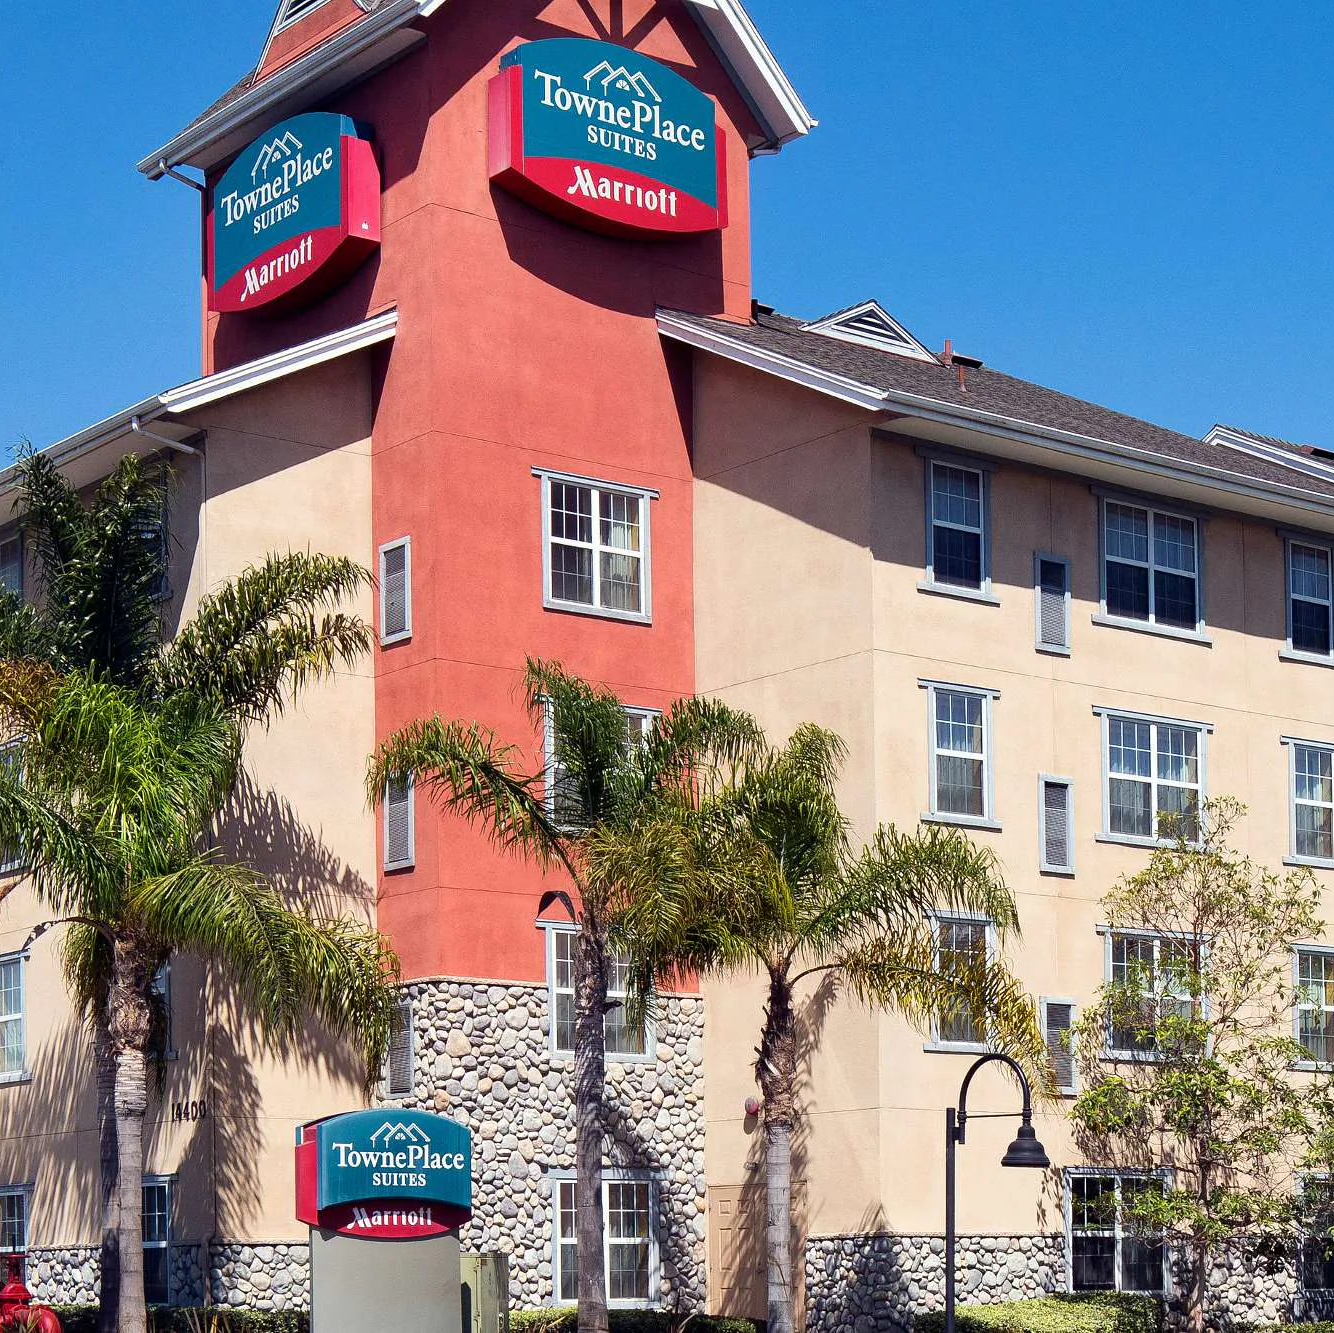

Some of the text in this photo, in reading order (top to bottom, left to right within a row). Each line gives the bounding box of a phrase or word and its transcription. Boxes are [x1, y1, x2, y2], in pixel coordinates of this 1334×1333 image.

[534, 69, 705, 150] TownePlace
[587, 125, 656, 160] SUITES
[221, 147, 333, 226] TownePlace
[567, 165, 677, 216] Marriott
[253, 195, 299, 234] SUITES
[240, 235, 313, 302] Marriott
[171, 1100, 207, 1123] 14400
[332, 1142, 465, 1170] TownePlace
[372, 1172, 427, 1187] SUITES
[347, 1207, 433, 1229] Marriott
